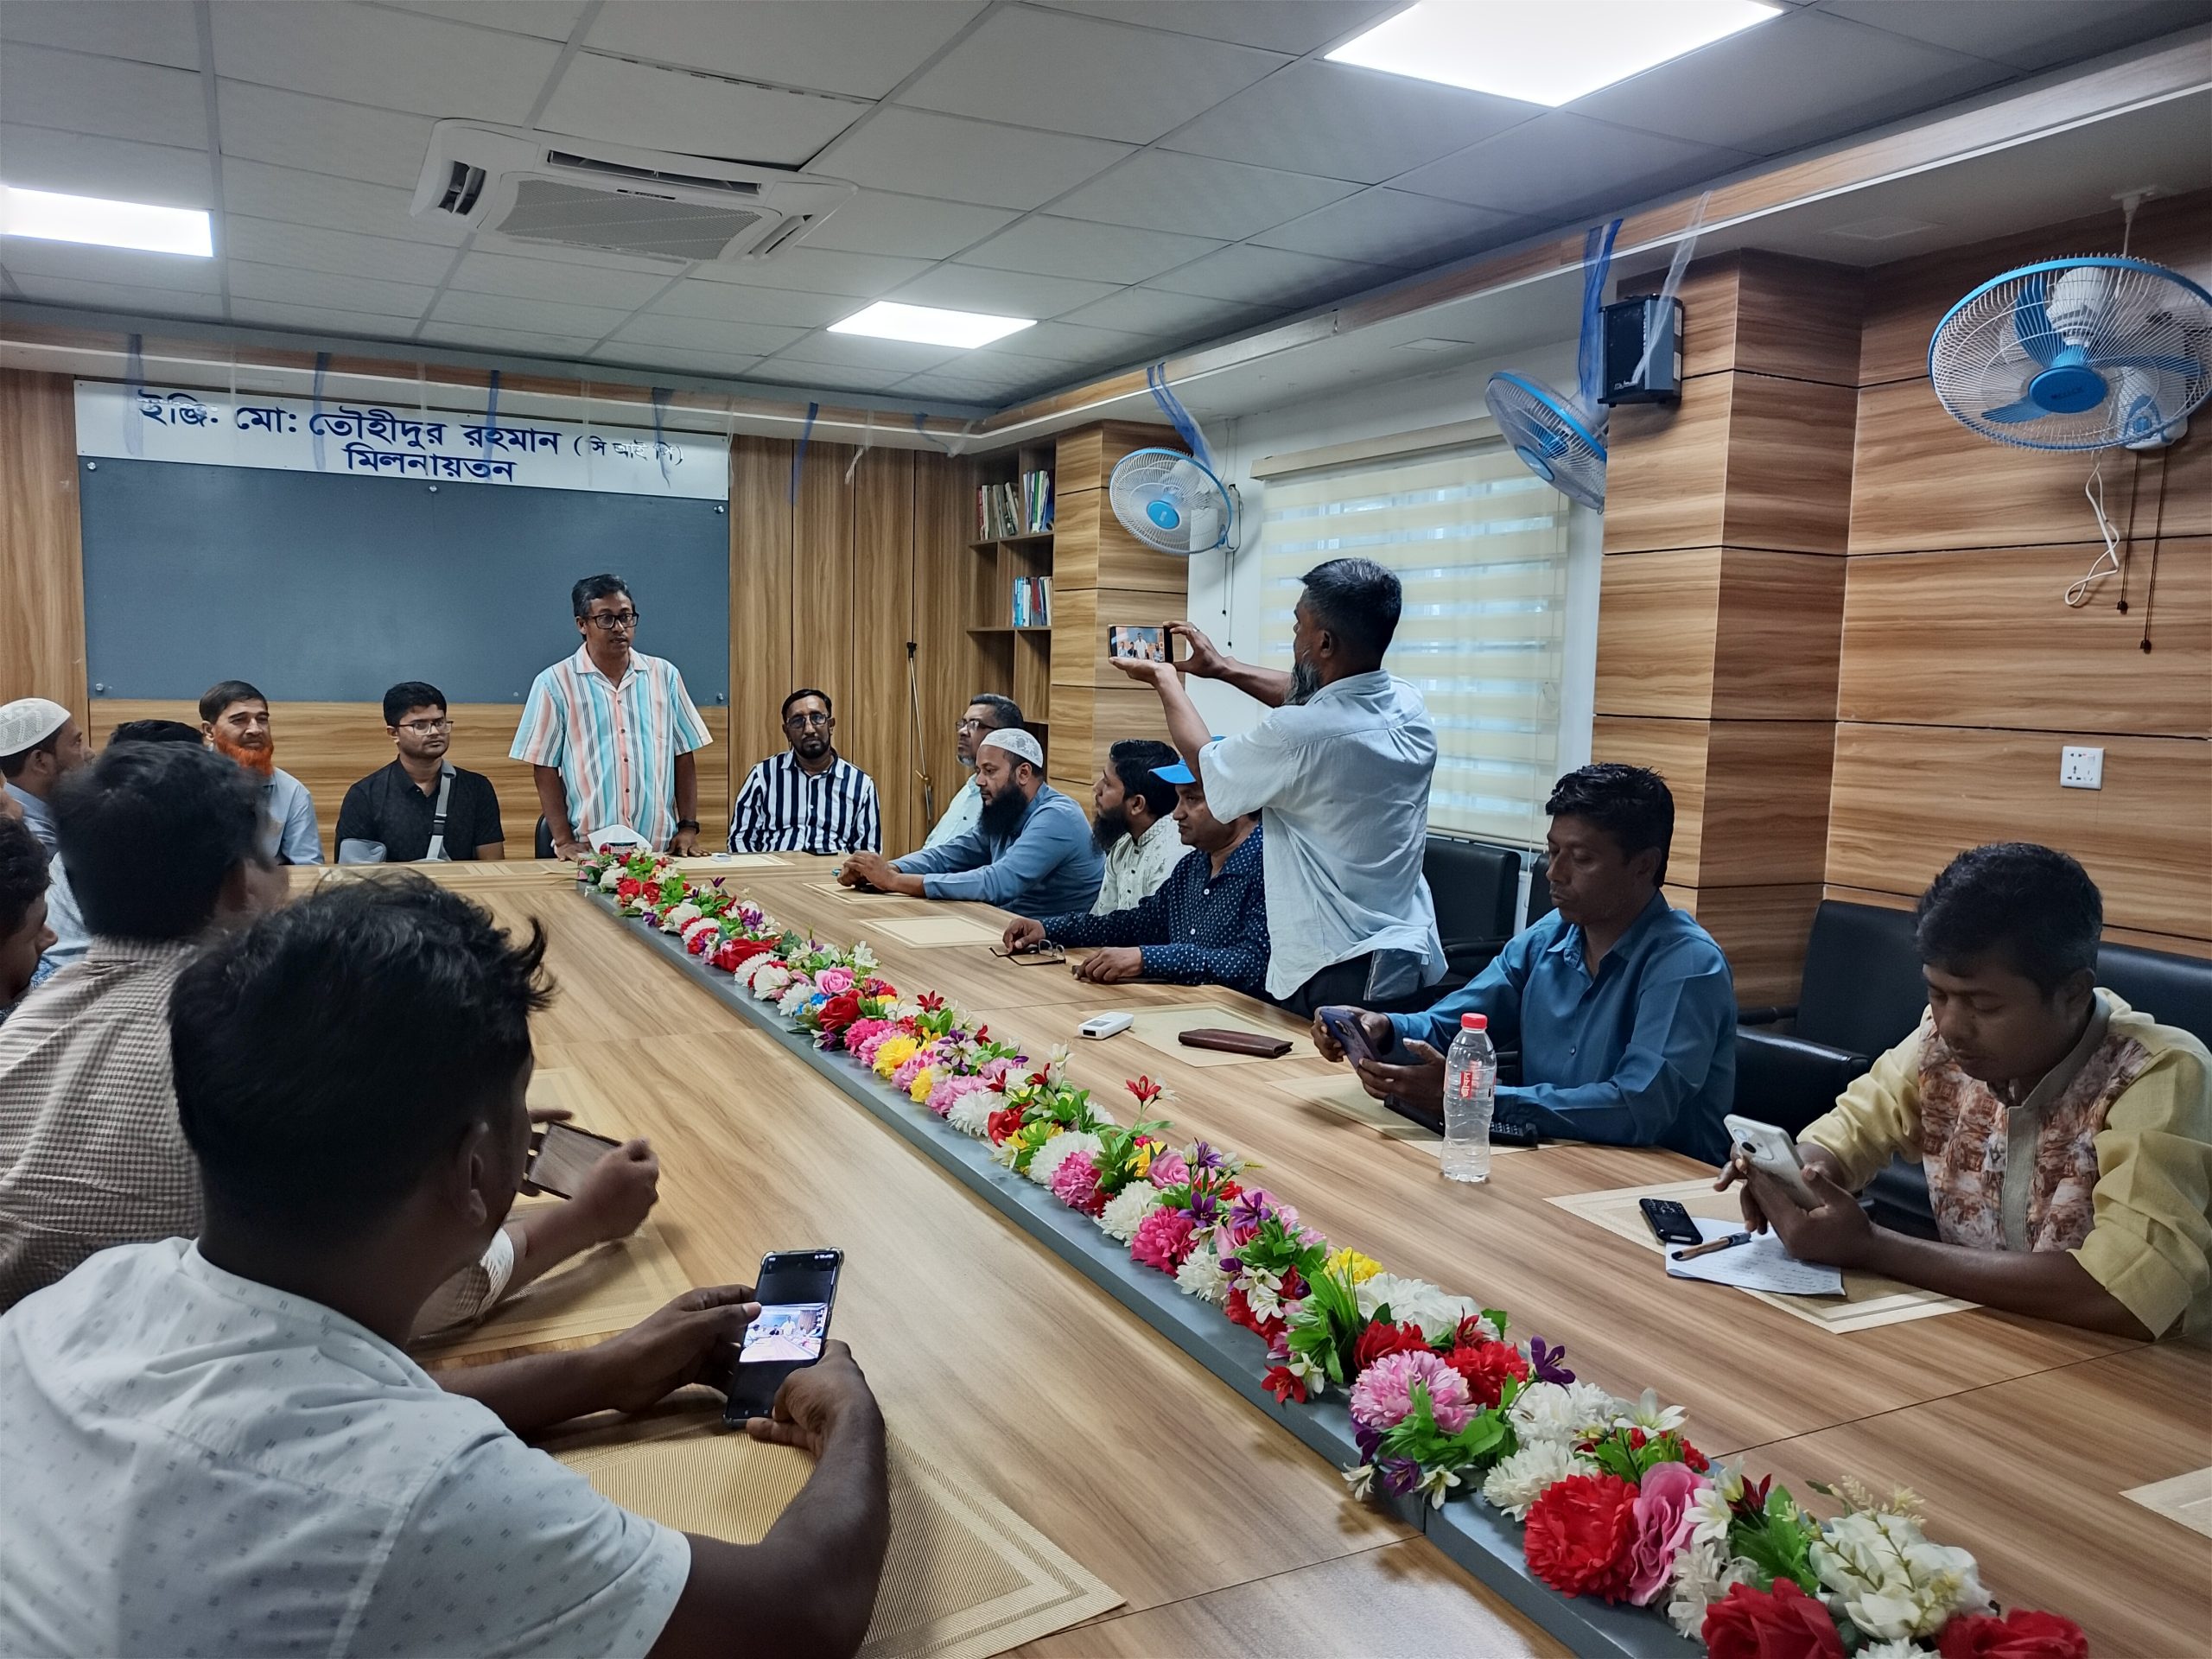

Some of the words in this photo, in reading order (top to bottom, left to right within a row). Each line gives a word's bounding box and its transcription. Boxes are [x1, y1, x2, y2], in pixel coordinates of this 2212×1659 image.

[309, 405, 448, 450] তৌহীদুর
[459, 423, 563, 454] রহমান
[341, 442, 518, 482] মিলনায়তন
